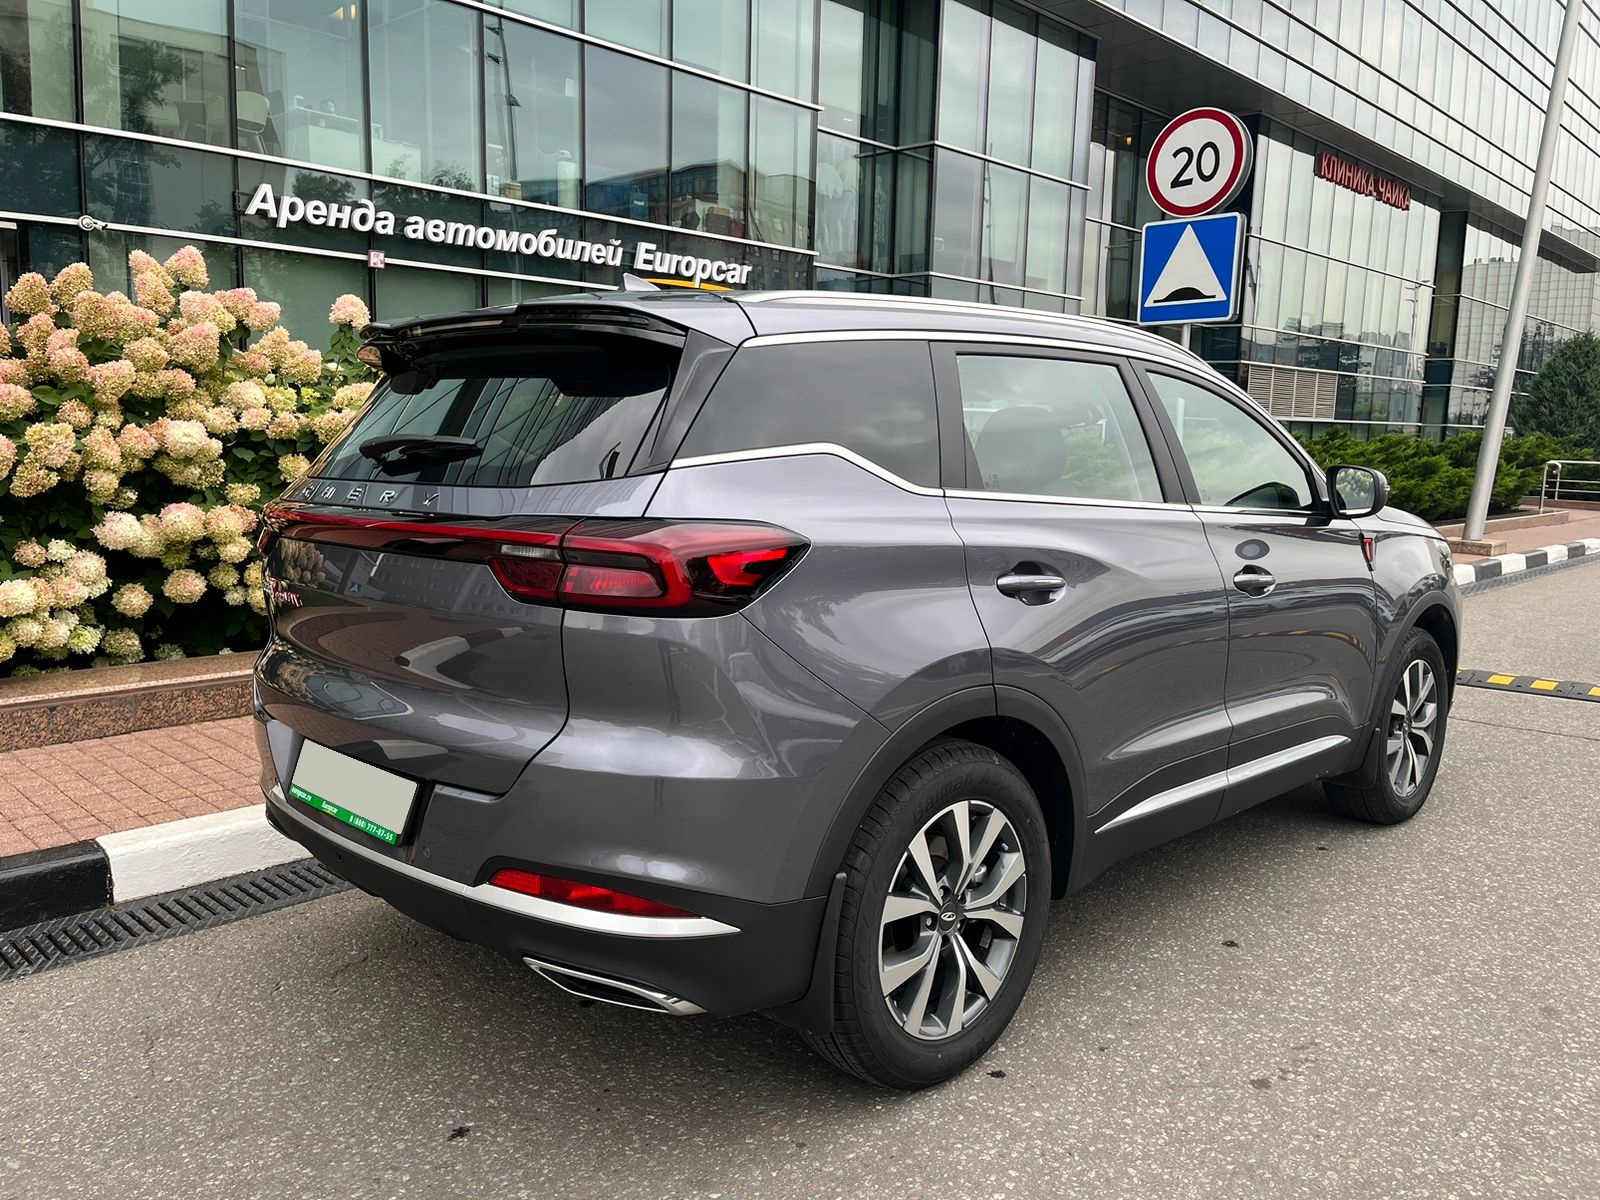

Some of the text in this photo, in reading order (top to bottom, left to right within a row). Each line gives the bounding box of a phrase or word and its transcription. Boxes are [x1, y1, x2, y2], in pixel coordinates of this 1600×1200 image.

[1170, 141, 1220, 189] 20
[1321, 152, 1377, 197] КЛИНИКА
[245, 183, 753, 288] Аренда автомобилей Europcar
